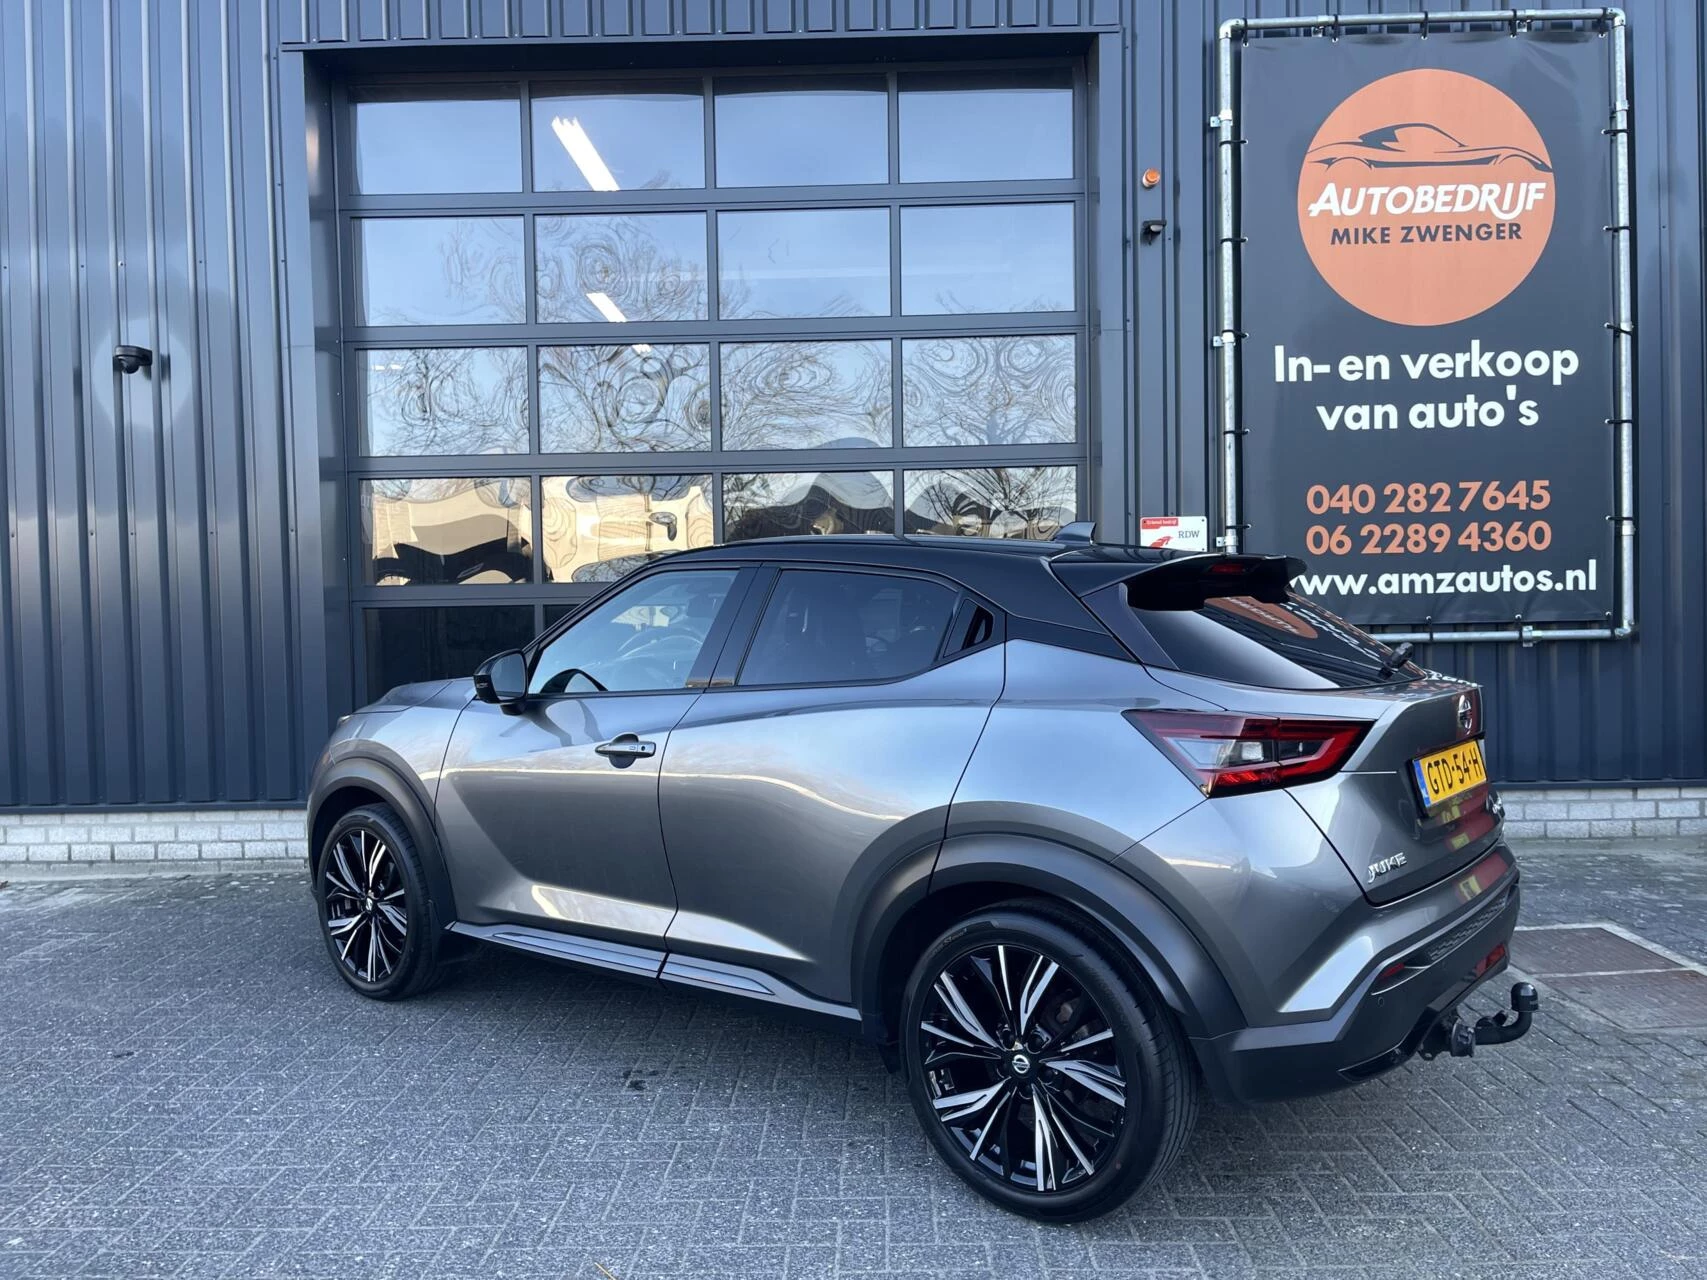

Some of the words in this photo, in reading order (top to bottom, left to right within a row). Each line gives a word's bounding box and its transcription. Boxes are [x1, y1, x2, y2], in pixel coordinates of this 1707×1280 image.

[1307, 181, 1547, 220] AUTOBEDRIJF
[1330, 226, 1391, 245] MIKE
[1400, 222, 1522, 243] ZWENGER
[1274, 345, 1331, 382] In-
[1338, 354, 1390, 381] en
[1401, 339, 1579, 385] verkoop
[1316, 403, 1398, 431] van
[1408, 384, 1539, 429] auto's
[1306, 484, 1376, 515] 040
[1383, 482, 1451, 513] 282
[1459, 480, 1551, 511] 7645
[1178, 530, 1200, 539] RDW
[1305, 525, 1352, 555] 06
[1360, 523, 1451, 554] 2289
[1458, 520, 1552, 551] 4360
[1427, 747, 1483, 795] GTD-54-H
[1367, 852, 1407, 884] JUKE
